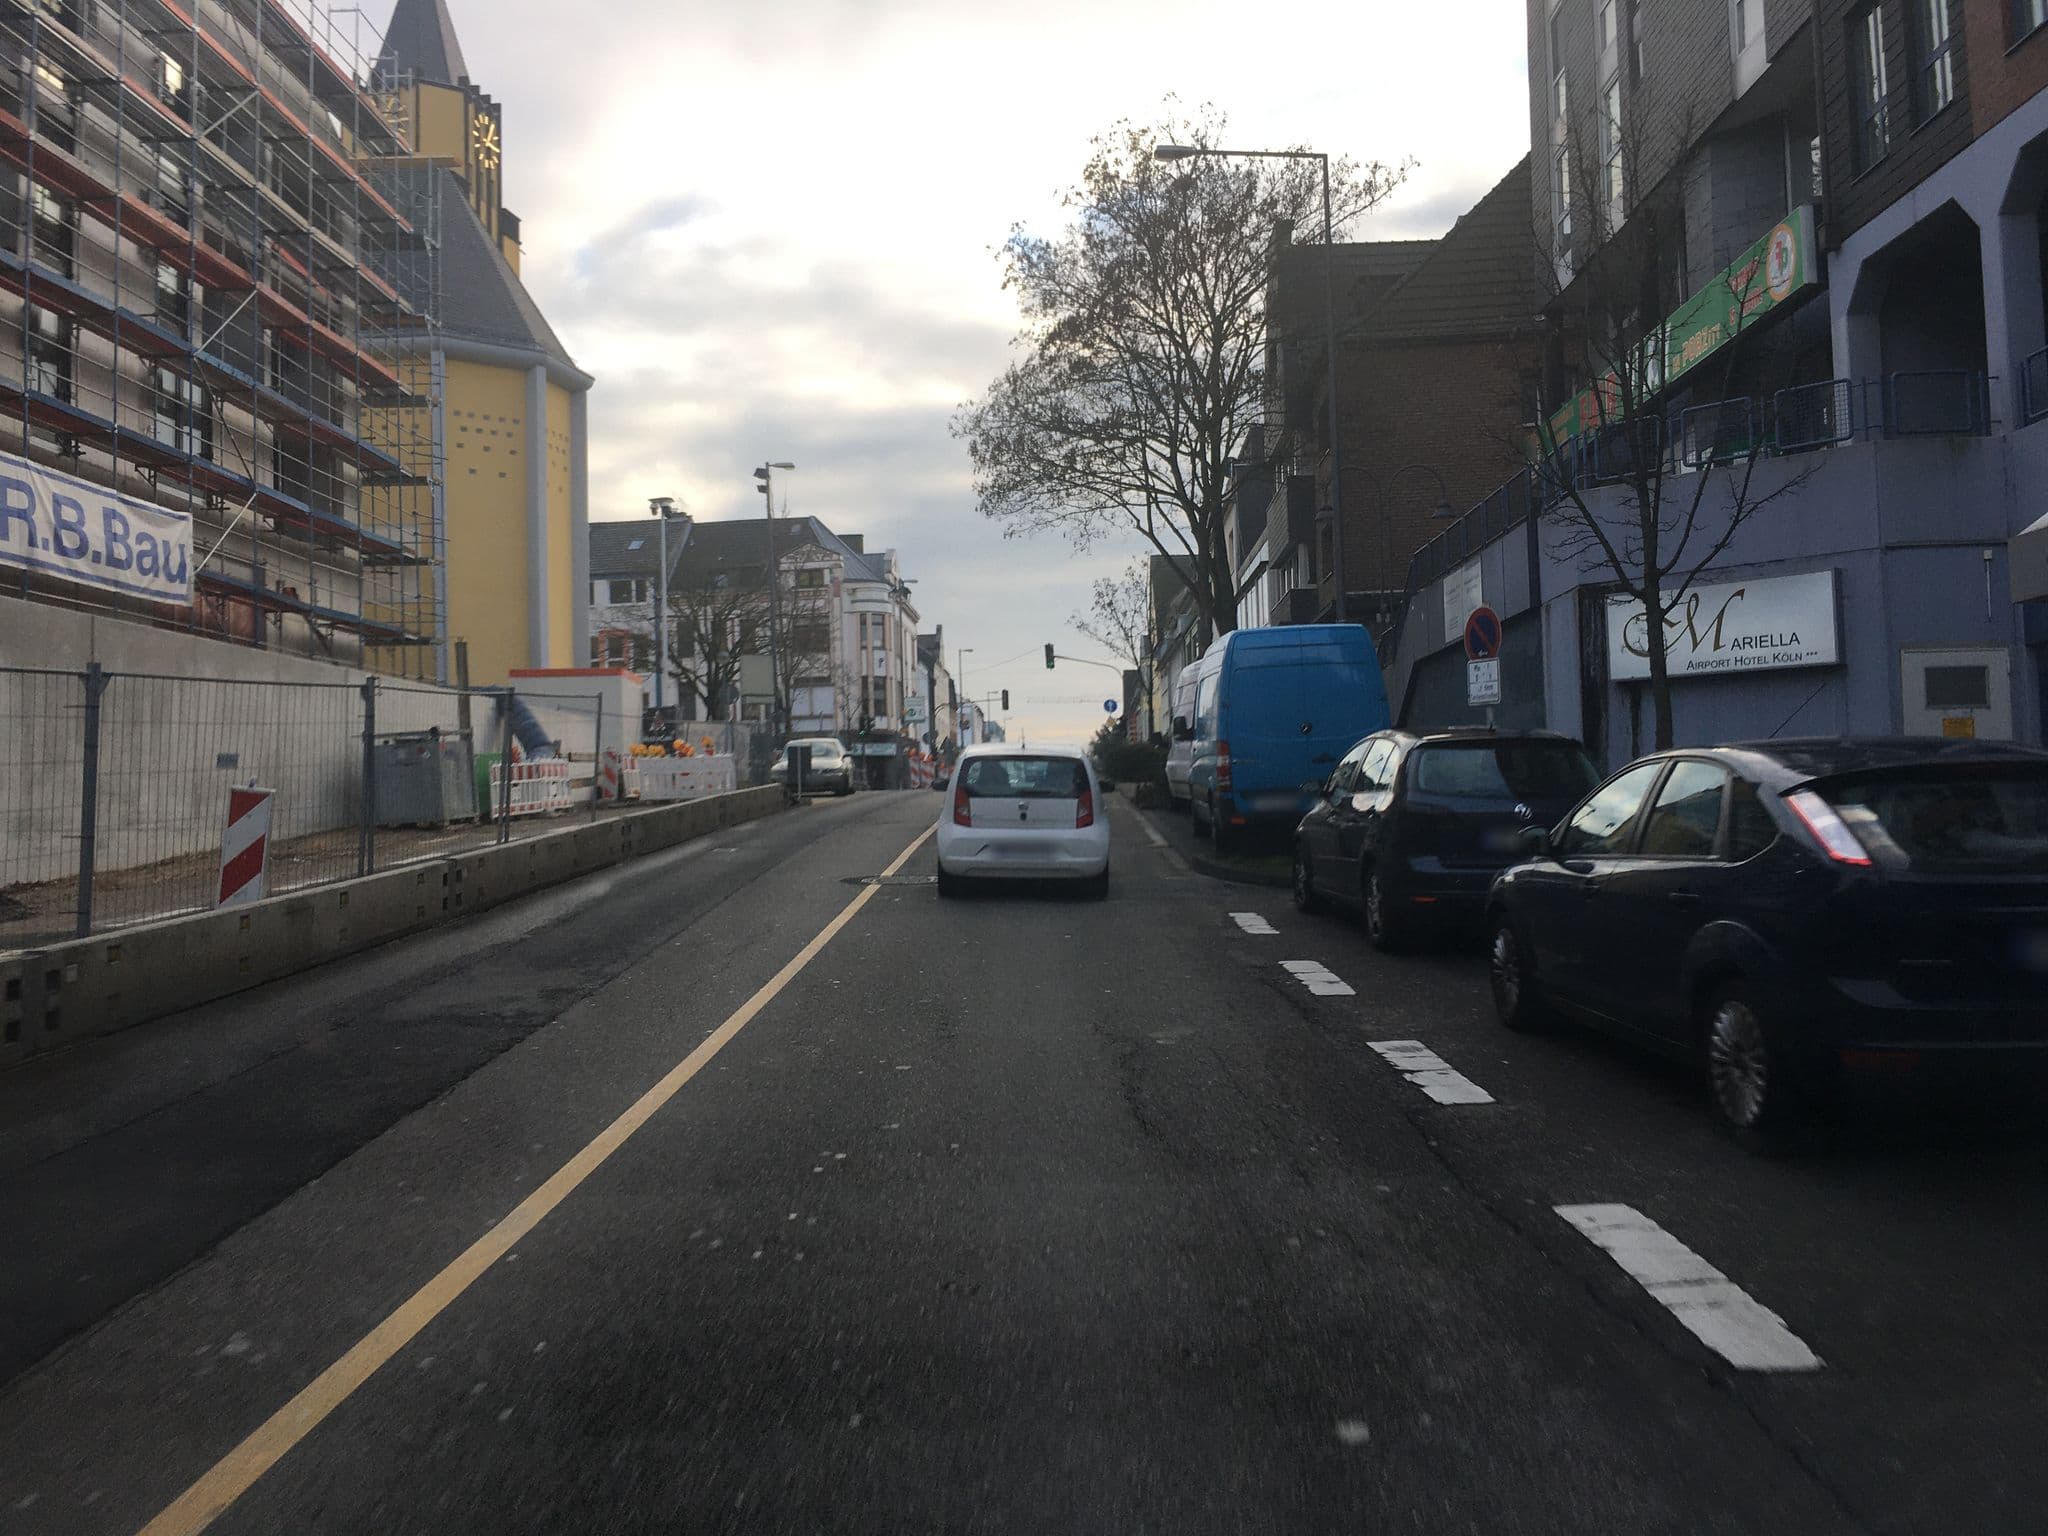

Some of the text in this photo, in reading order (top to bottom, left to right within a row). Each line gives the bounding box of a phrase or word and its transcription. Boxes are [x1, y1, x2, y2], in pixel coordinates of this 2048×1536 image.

[1686, 650, 1803, 671] AIRPORT HOTEL KÖLN
